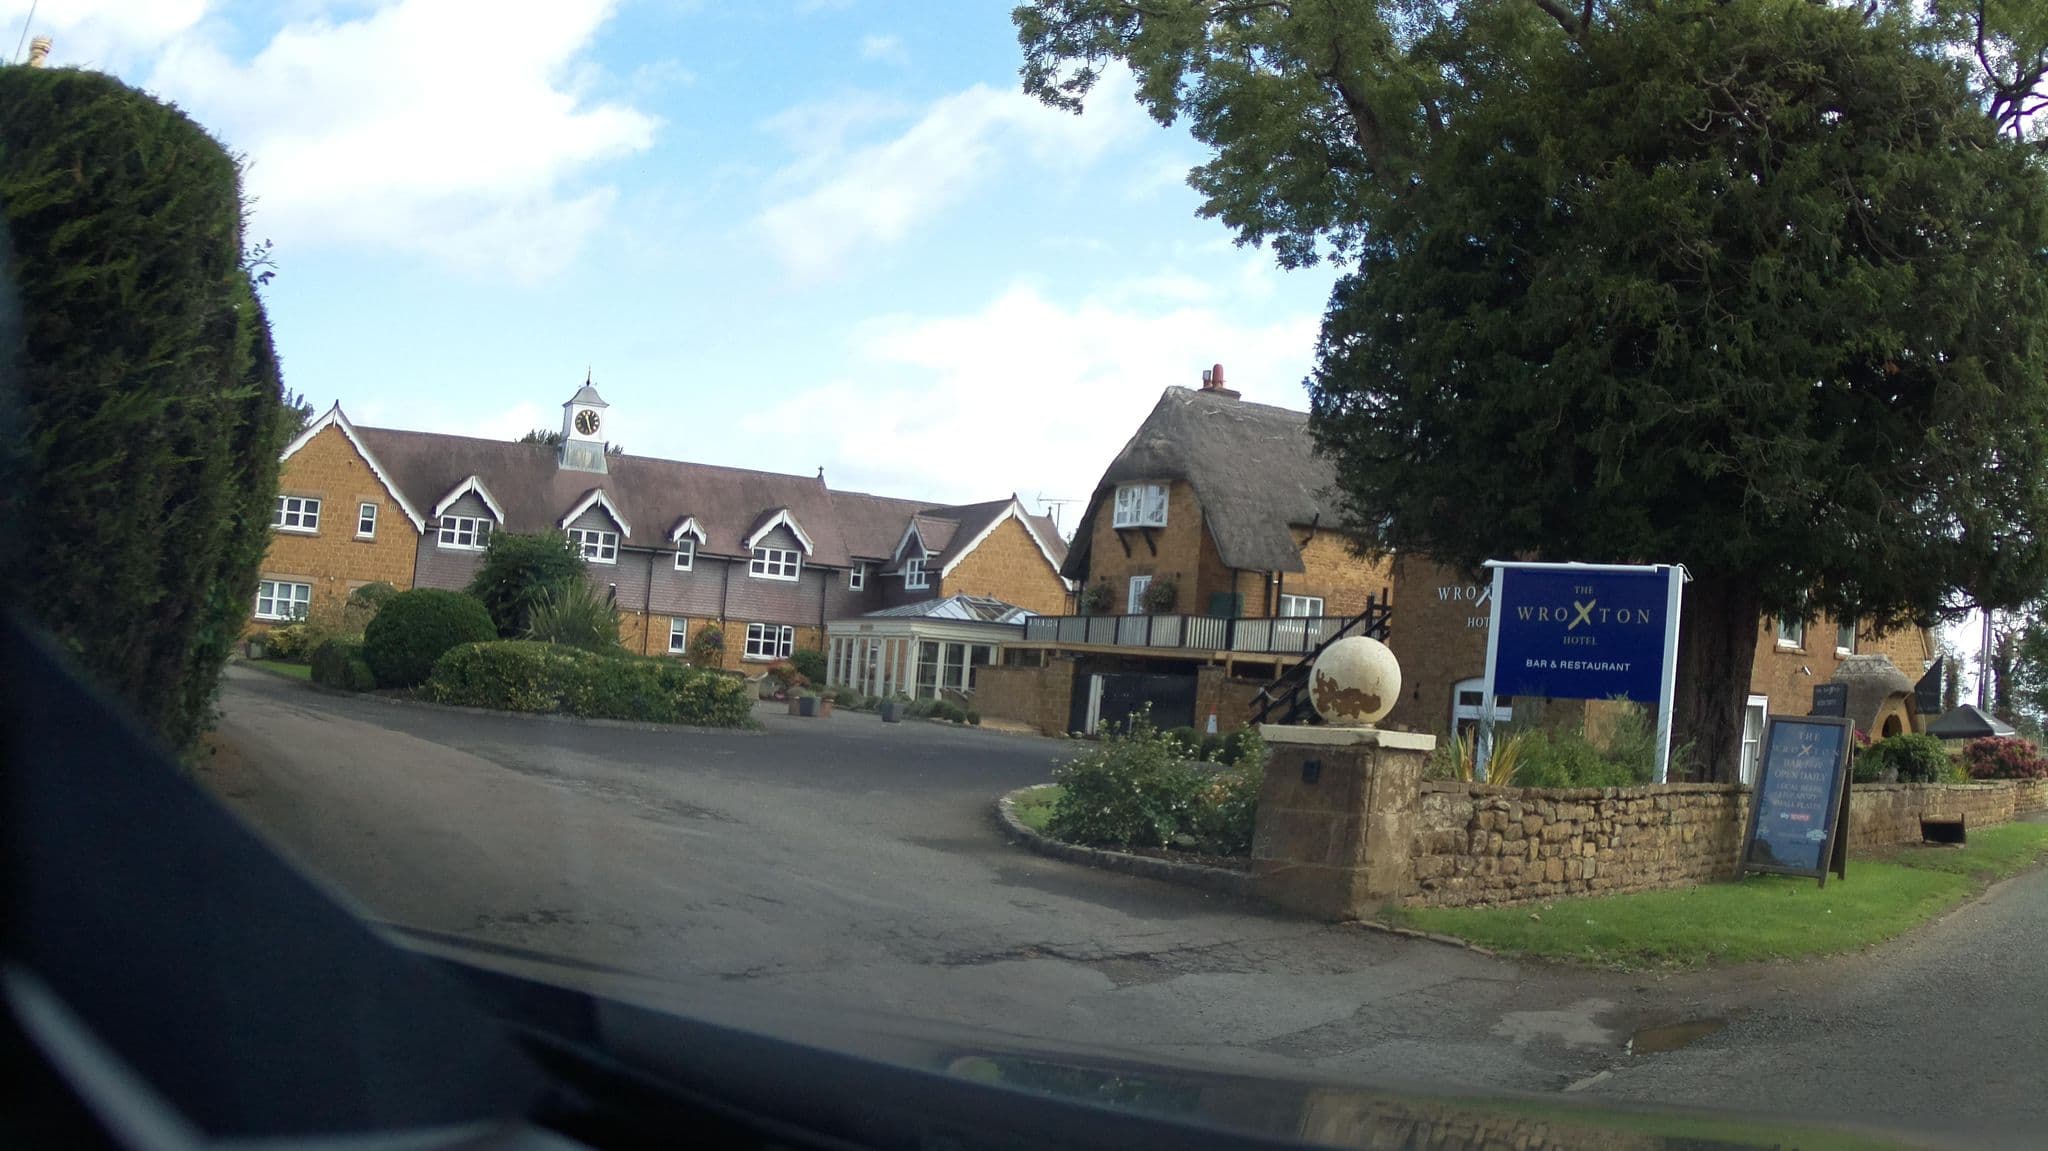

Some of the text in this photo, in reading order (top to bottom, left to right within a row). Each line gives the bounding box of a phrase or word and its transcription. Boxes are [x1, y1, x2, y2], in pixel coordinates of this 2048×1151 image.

[1574, 586, 1593, 595] THE
[1517, 599, 1651, 630] WROXTON
[1563, 636, 1598, 646] HOTEL
[1526, 659, 1631, 672] BAR & RESTAURANT
[1800, 731, 1820, 742] THE
[1774, 769, 1826, 783] OPEN DAILY
